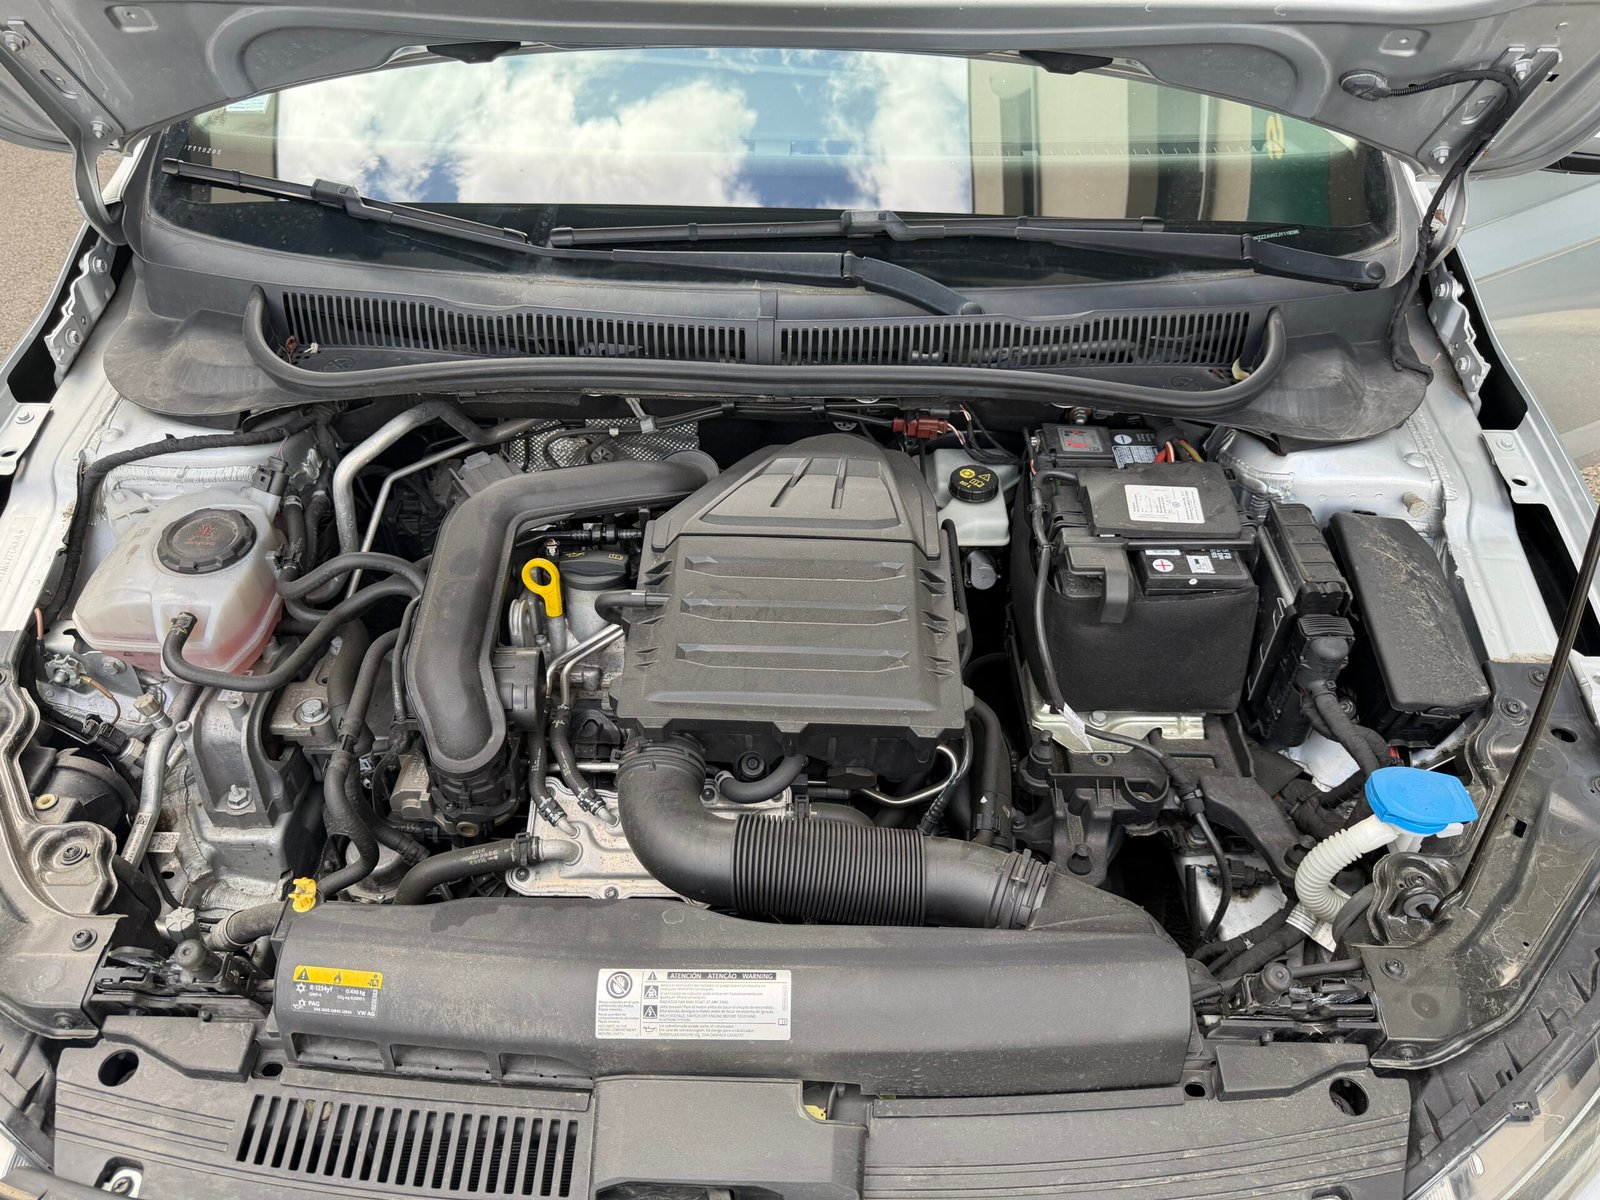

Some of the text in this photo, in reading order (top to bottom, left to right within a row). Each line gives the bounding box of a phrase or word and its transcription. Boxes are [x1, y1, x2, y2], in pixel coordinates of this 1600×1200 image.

[670, 971, 701, 980] ATENCIÓN
[707, 971, 737, 982] ATENÇÃO
[309, 984, 333, 994] R-1234yf
